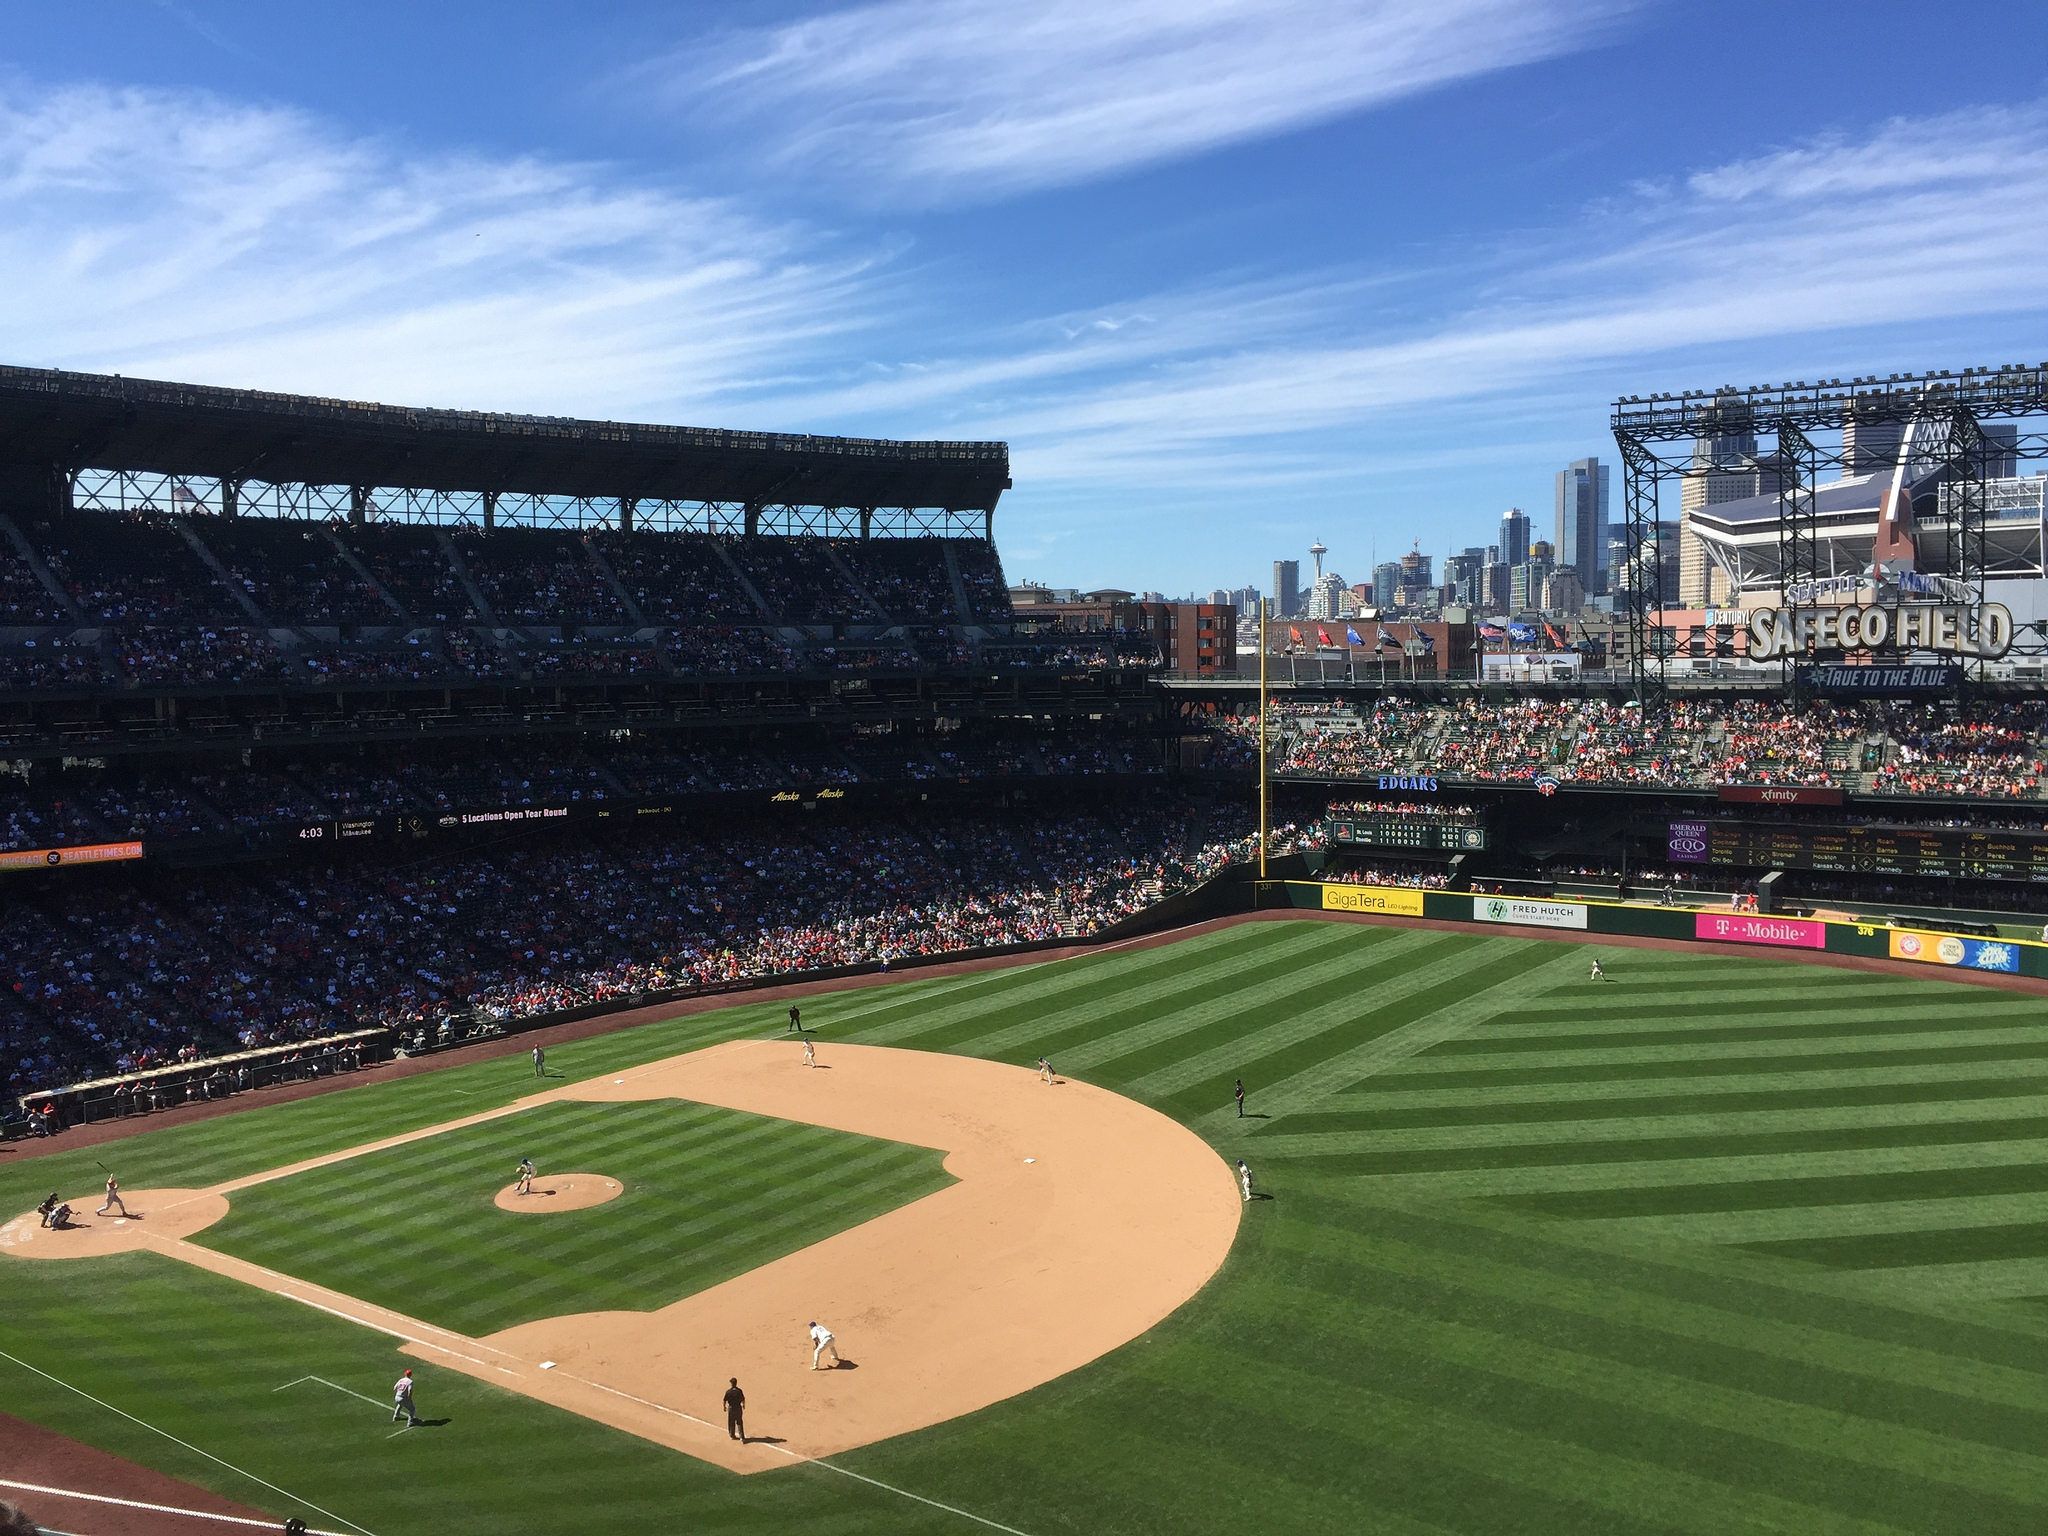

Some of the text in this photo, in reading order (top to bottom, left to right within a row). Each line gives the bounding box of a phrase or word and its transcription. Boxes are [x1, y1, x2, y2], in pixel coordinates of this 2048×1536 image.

[1788, 570, 1972, 602] SEATTLE MARINERS
[1749, 602, 2013, 662] SAFECO FIELD
[1826, 667, 1949, 686] TRUE TO THE BLUE
[1378, 776, 1438, 792] EDGARS
[771, 791, 800, 802] Alaska
[816, 788, 845, 799] Alaska
[1761, 789, 1798, 802] xfinity
[462, 815, 467, 823] 5
[468, 811, 503, 823] Locations
[504, 811, 524, 821] Open
[524, 809, 542, 818] Year
[543, 807, 567, 817] Round
[341, 820, 374, 829] Washington
[1670, 824, 1706, 832] EMERALD
[299, 827, 323, 839] 4:03
[1674, 839, 1705, 853] EQC
[63, 845, 142, 861] SEATTLETIMES.COM
[1327, 891, 1385, 909] GigaTera
[1512, 905, 1538, 914] FRED
[1540, 906, 1574, 916] HUTCH
[1857, 926, 1874, 936] 376
